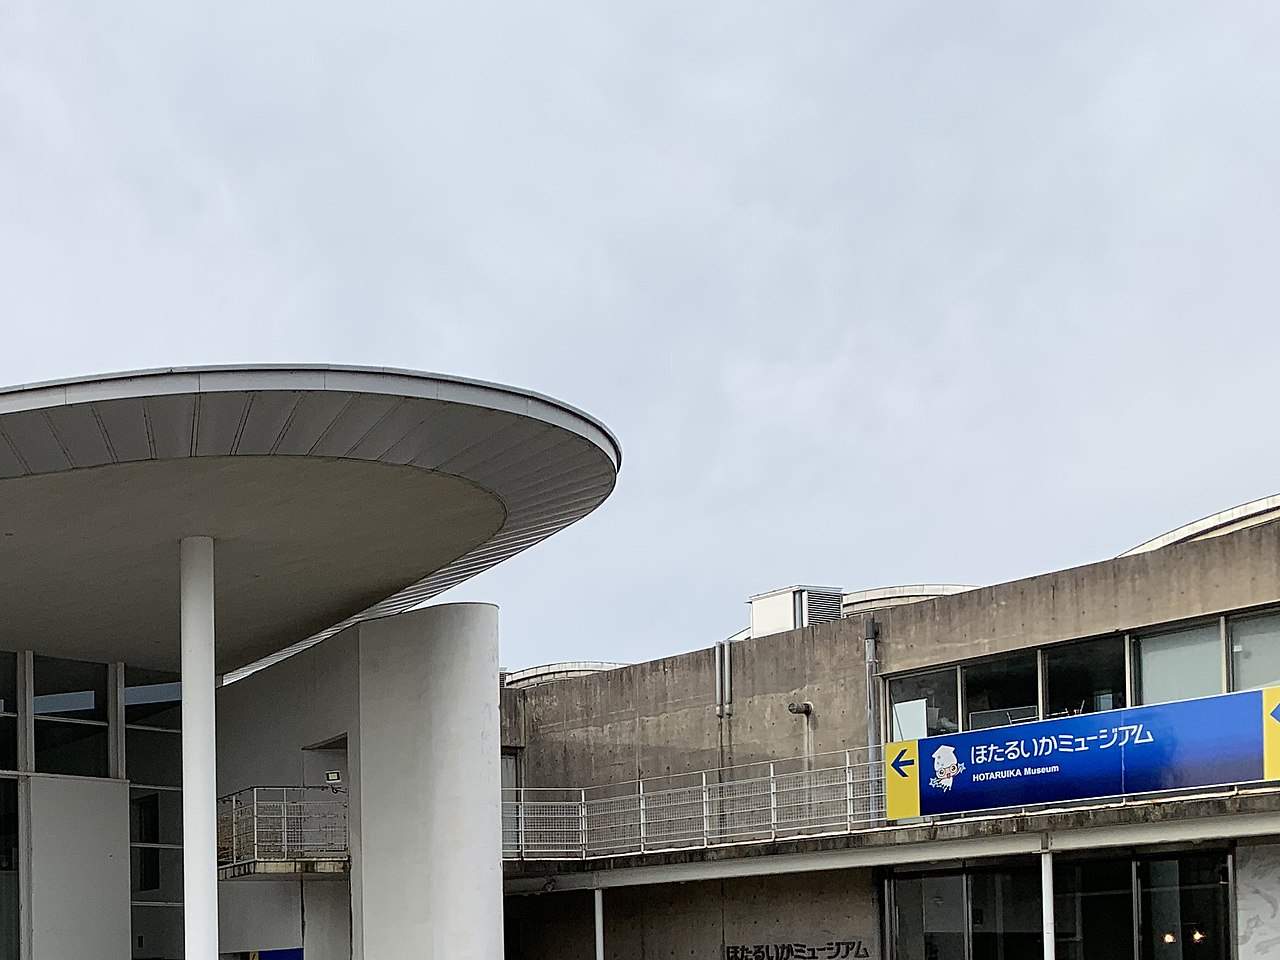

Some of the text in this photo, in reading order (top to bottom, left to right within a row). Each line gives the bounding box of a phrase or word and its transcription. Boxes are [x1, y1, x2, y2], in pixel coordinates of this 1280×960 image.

[971, 724, 1154, 764] ほたるいかミュージアム
[972, 765, 1060, 782] HOTARUIKA Museum
